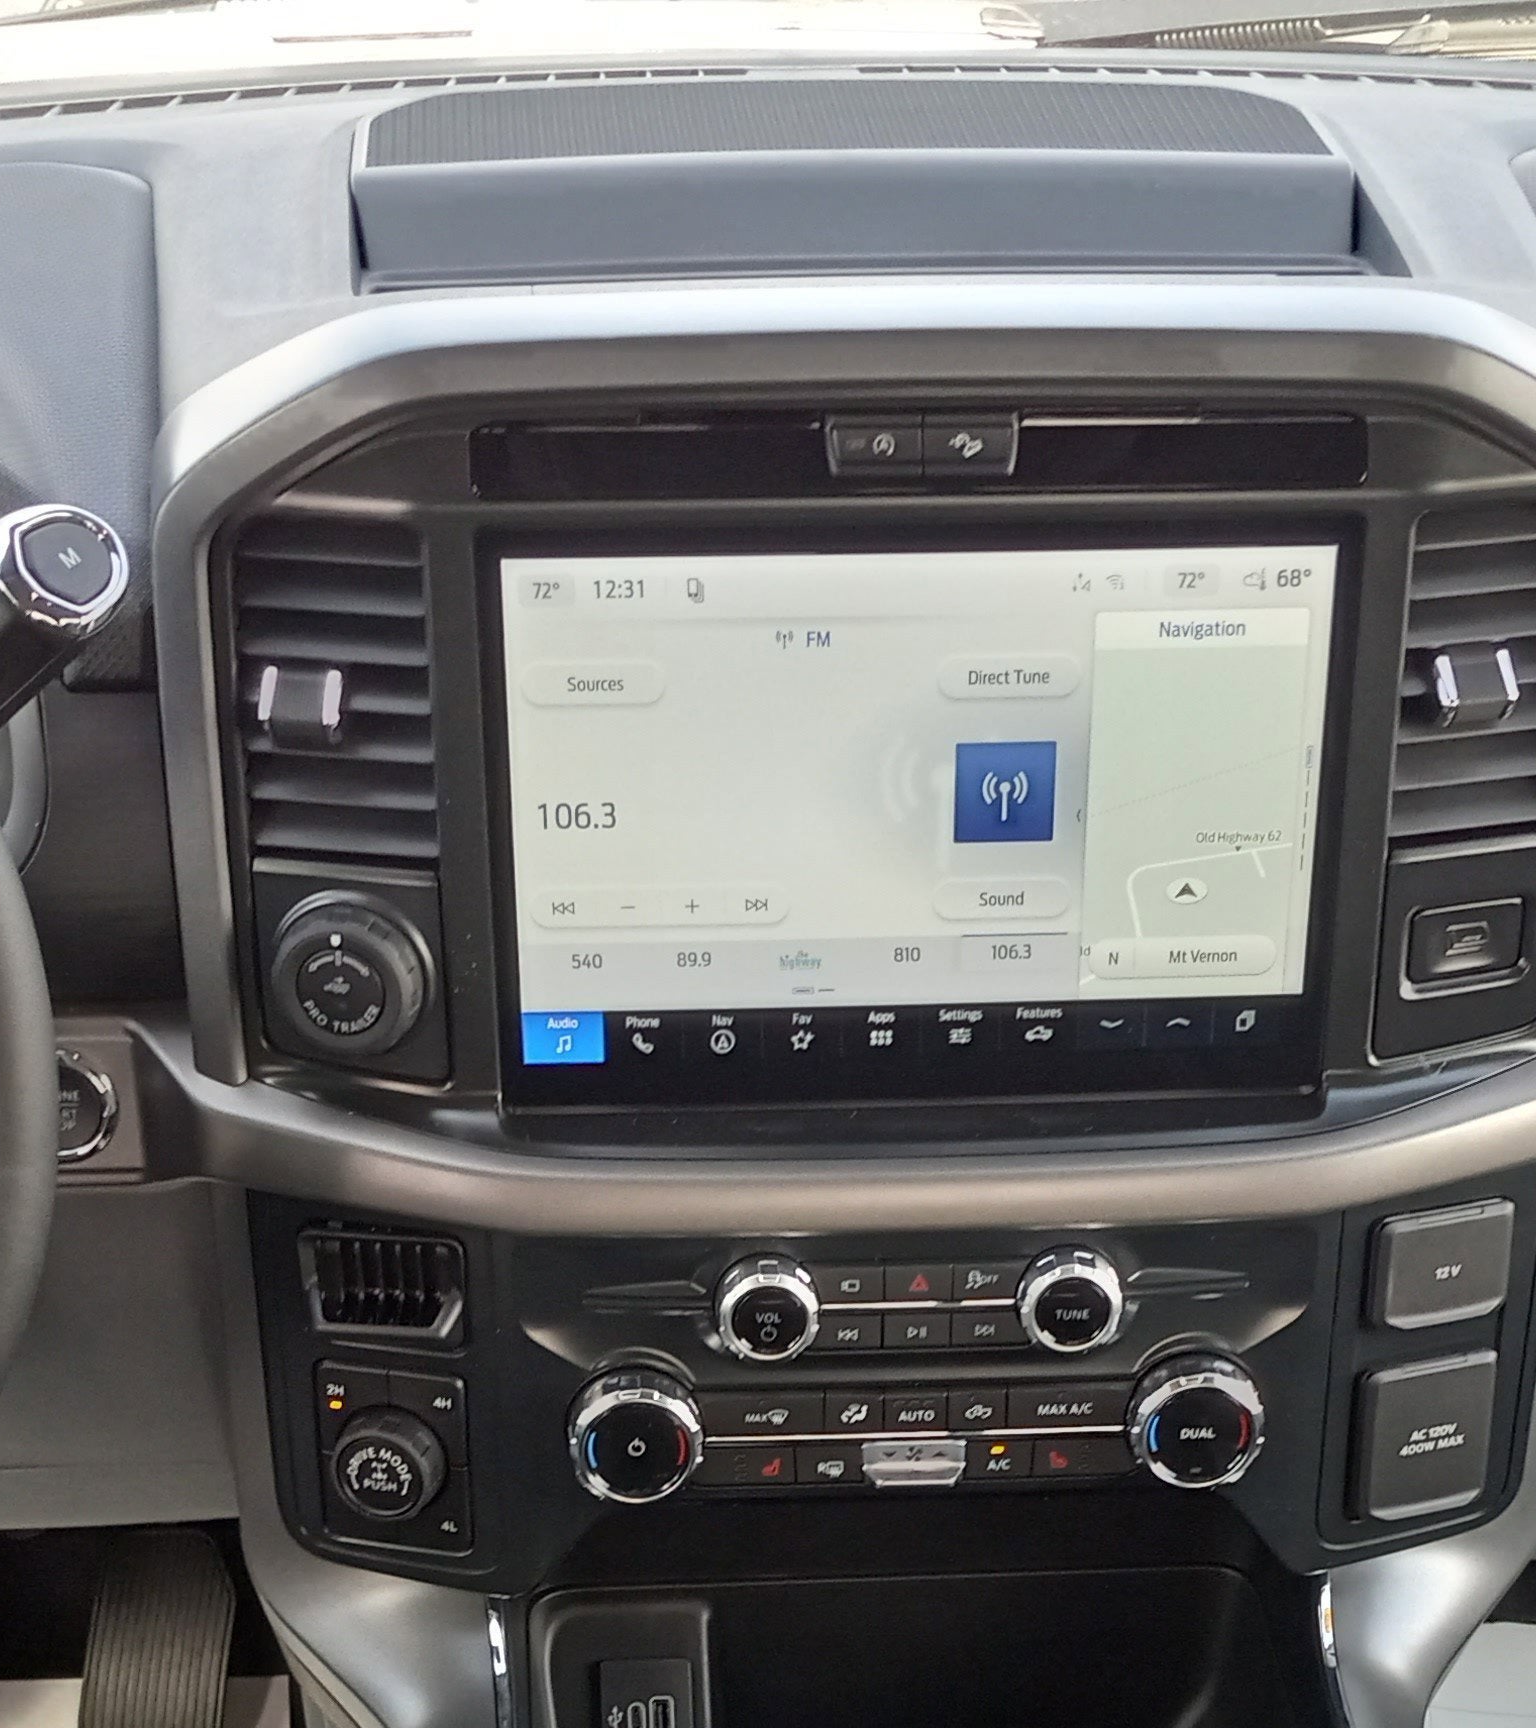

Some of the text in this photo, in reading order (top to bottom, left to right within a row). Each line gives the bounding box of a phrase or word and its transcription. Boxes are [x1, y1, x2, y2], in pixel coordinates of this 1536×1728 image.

[57, 547, 82, 570] M
[1177, 571, 1206, 589] 72°
[1277, 568, 1313, 588] 68°
[532, 581, 560, 600] 72°
[594, 579, 645, 599] 12:31
[1159, 621, 1246, 640] Navigation
[806, 631, 831, 648] FM
[567, 676, 624, 692] Sources
[968, 668, 1050, 686] Direct Tune
[538, 802, 617, 830] 106.3
[1196, 830, 1282, 845] Old Highway 62
[979, 891, 1025, 908] Sound
[676, 951, 712, 968] 89.9
[894, 947, 921, 964] 810
[991, 944, 1032, 961] 106.3
[1108, 952, 1119, 965] N
[1168, 950, 1238, 963] Mt Vernon
[572, 953, 603, 969] 540
[303, 1000, 328, 1027] PRO
[711, 1014, 733, 1028] Nav
[792, 1013, 812, 1027] Fav
[867, 1011, 896, 1026] Apps
[939, 1008, 984, 1023] Settings
[1016, 1007, 1063, 1020] Features
[547, 1017, 579, 1030] Audio
[625, 1016, 660, 1029] Phone
[756, 1312, 782, 1325] VOL
[1056, 1308, 1090, 1321] TUNE
[326, 1384, 345, 1396] 2H
[433, 1397, 452, 1410] 4H
[1037, 1401, 1094, 1416] MAX A/C
[745, 1412, 768, 1424] MAX
[897, 1410, 935, 1422] AUTO
[1180, 1427, 1216, 1440] DUAL
[1409, 1422, 1458, 1443] AC 120V
[1399, 1432, 1465, 1457] 400W MAX
[987, 1458, 1011, 1471] A/C
[440, 1521, 459, 1533] 4L
